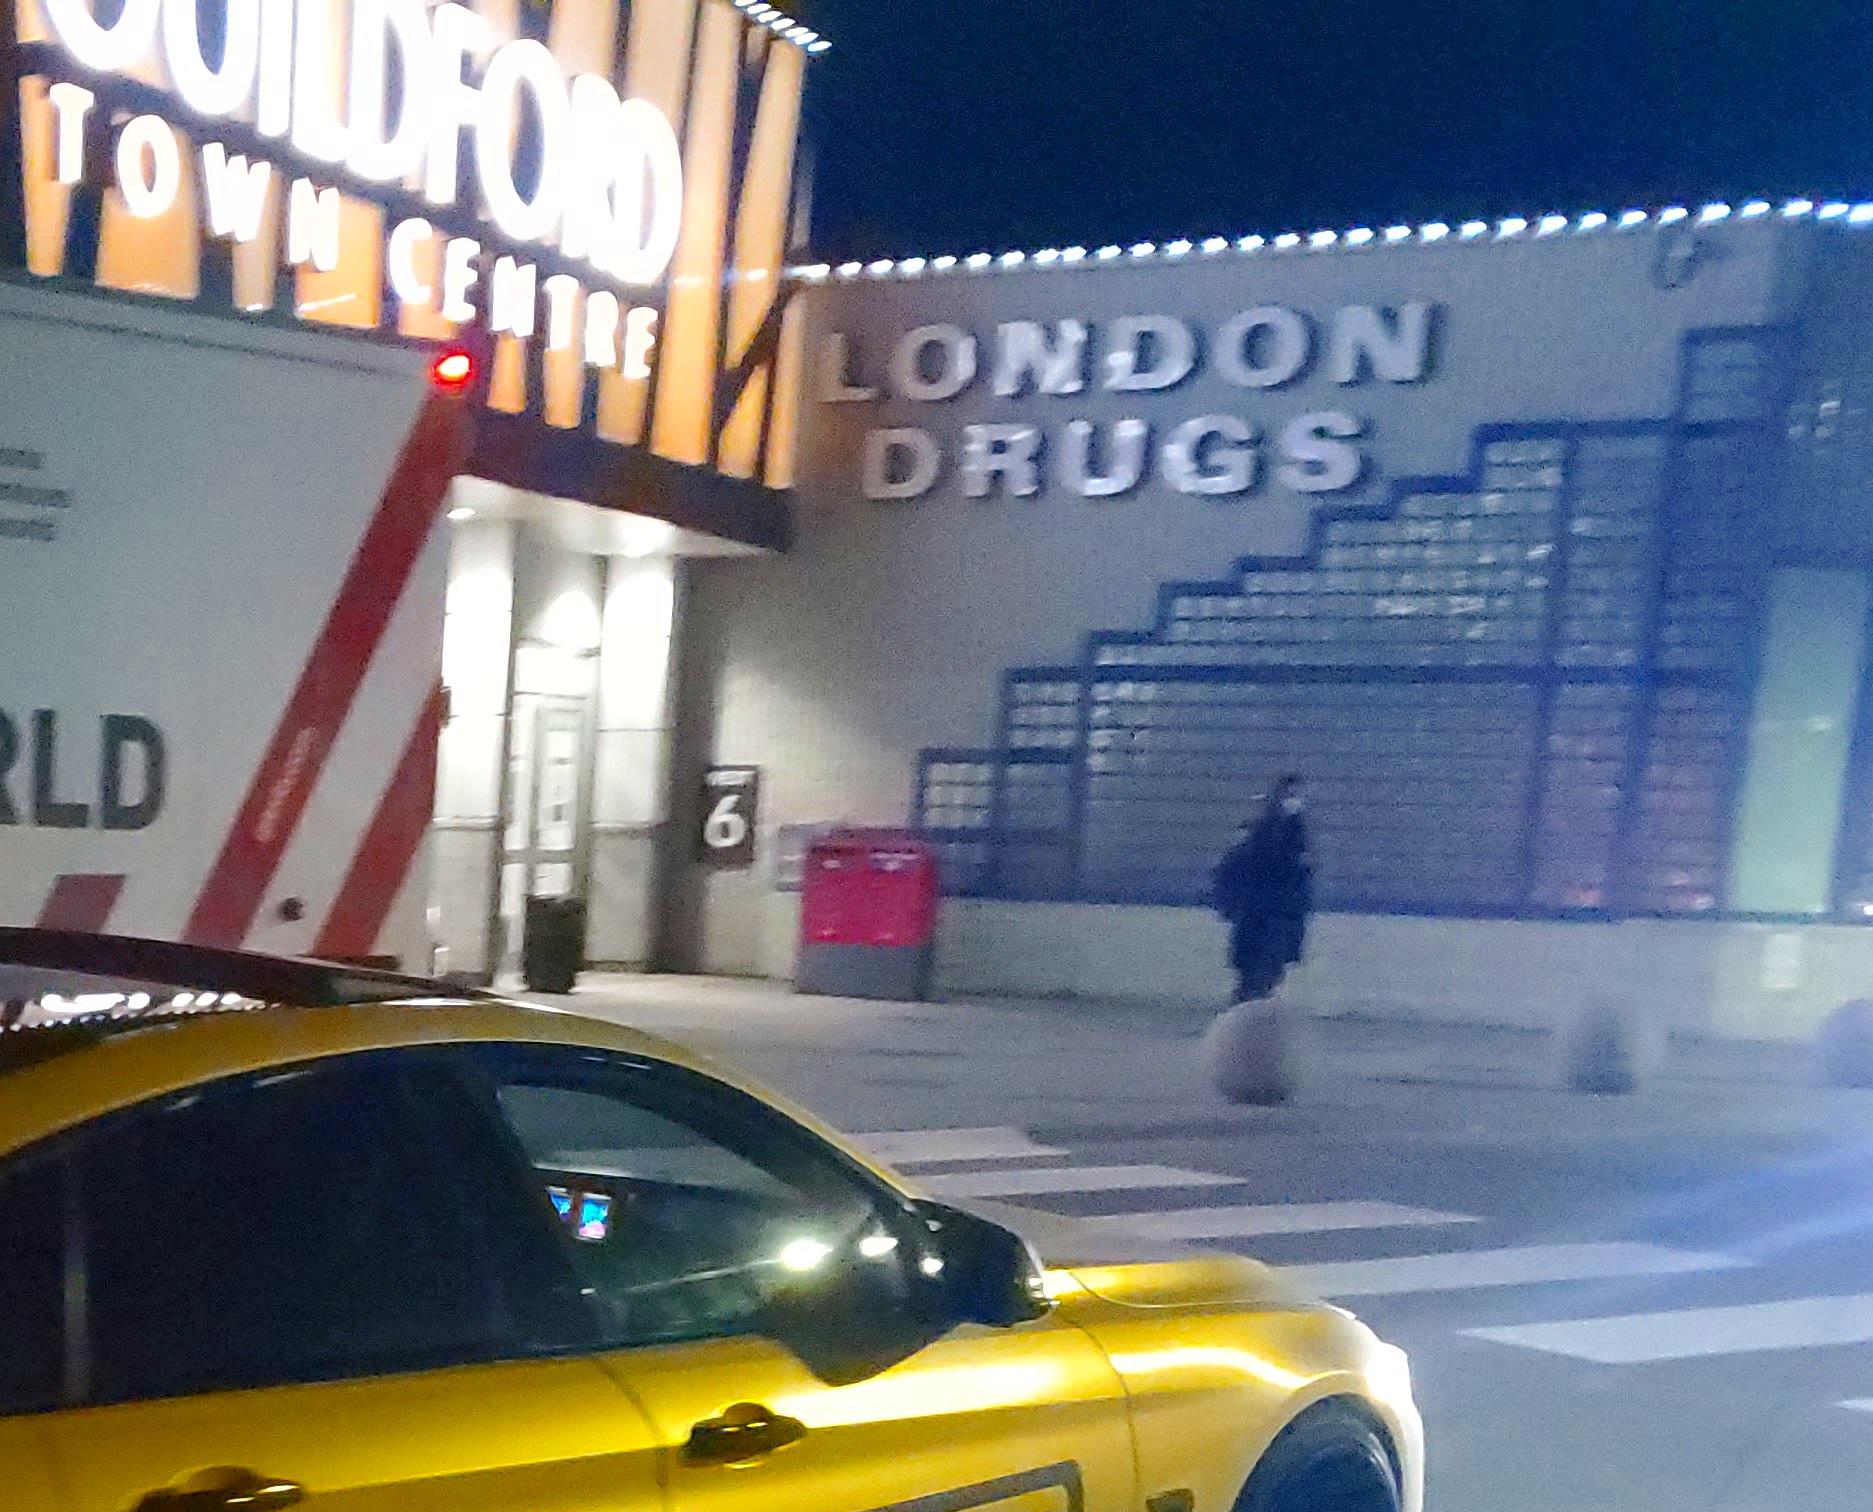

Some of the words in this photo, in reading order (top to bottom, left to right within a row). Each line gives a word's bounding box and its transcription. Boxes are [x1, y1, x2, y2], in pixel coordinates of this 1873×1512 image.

[49, 83, 341, 271] TOWN
[389, 217, 660, 379] CENTRE
[820, 299, 1440, 402] LONDON
[861, 408, 1368, 500] DRUGS
[704, 795, 746, 848] 6
